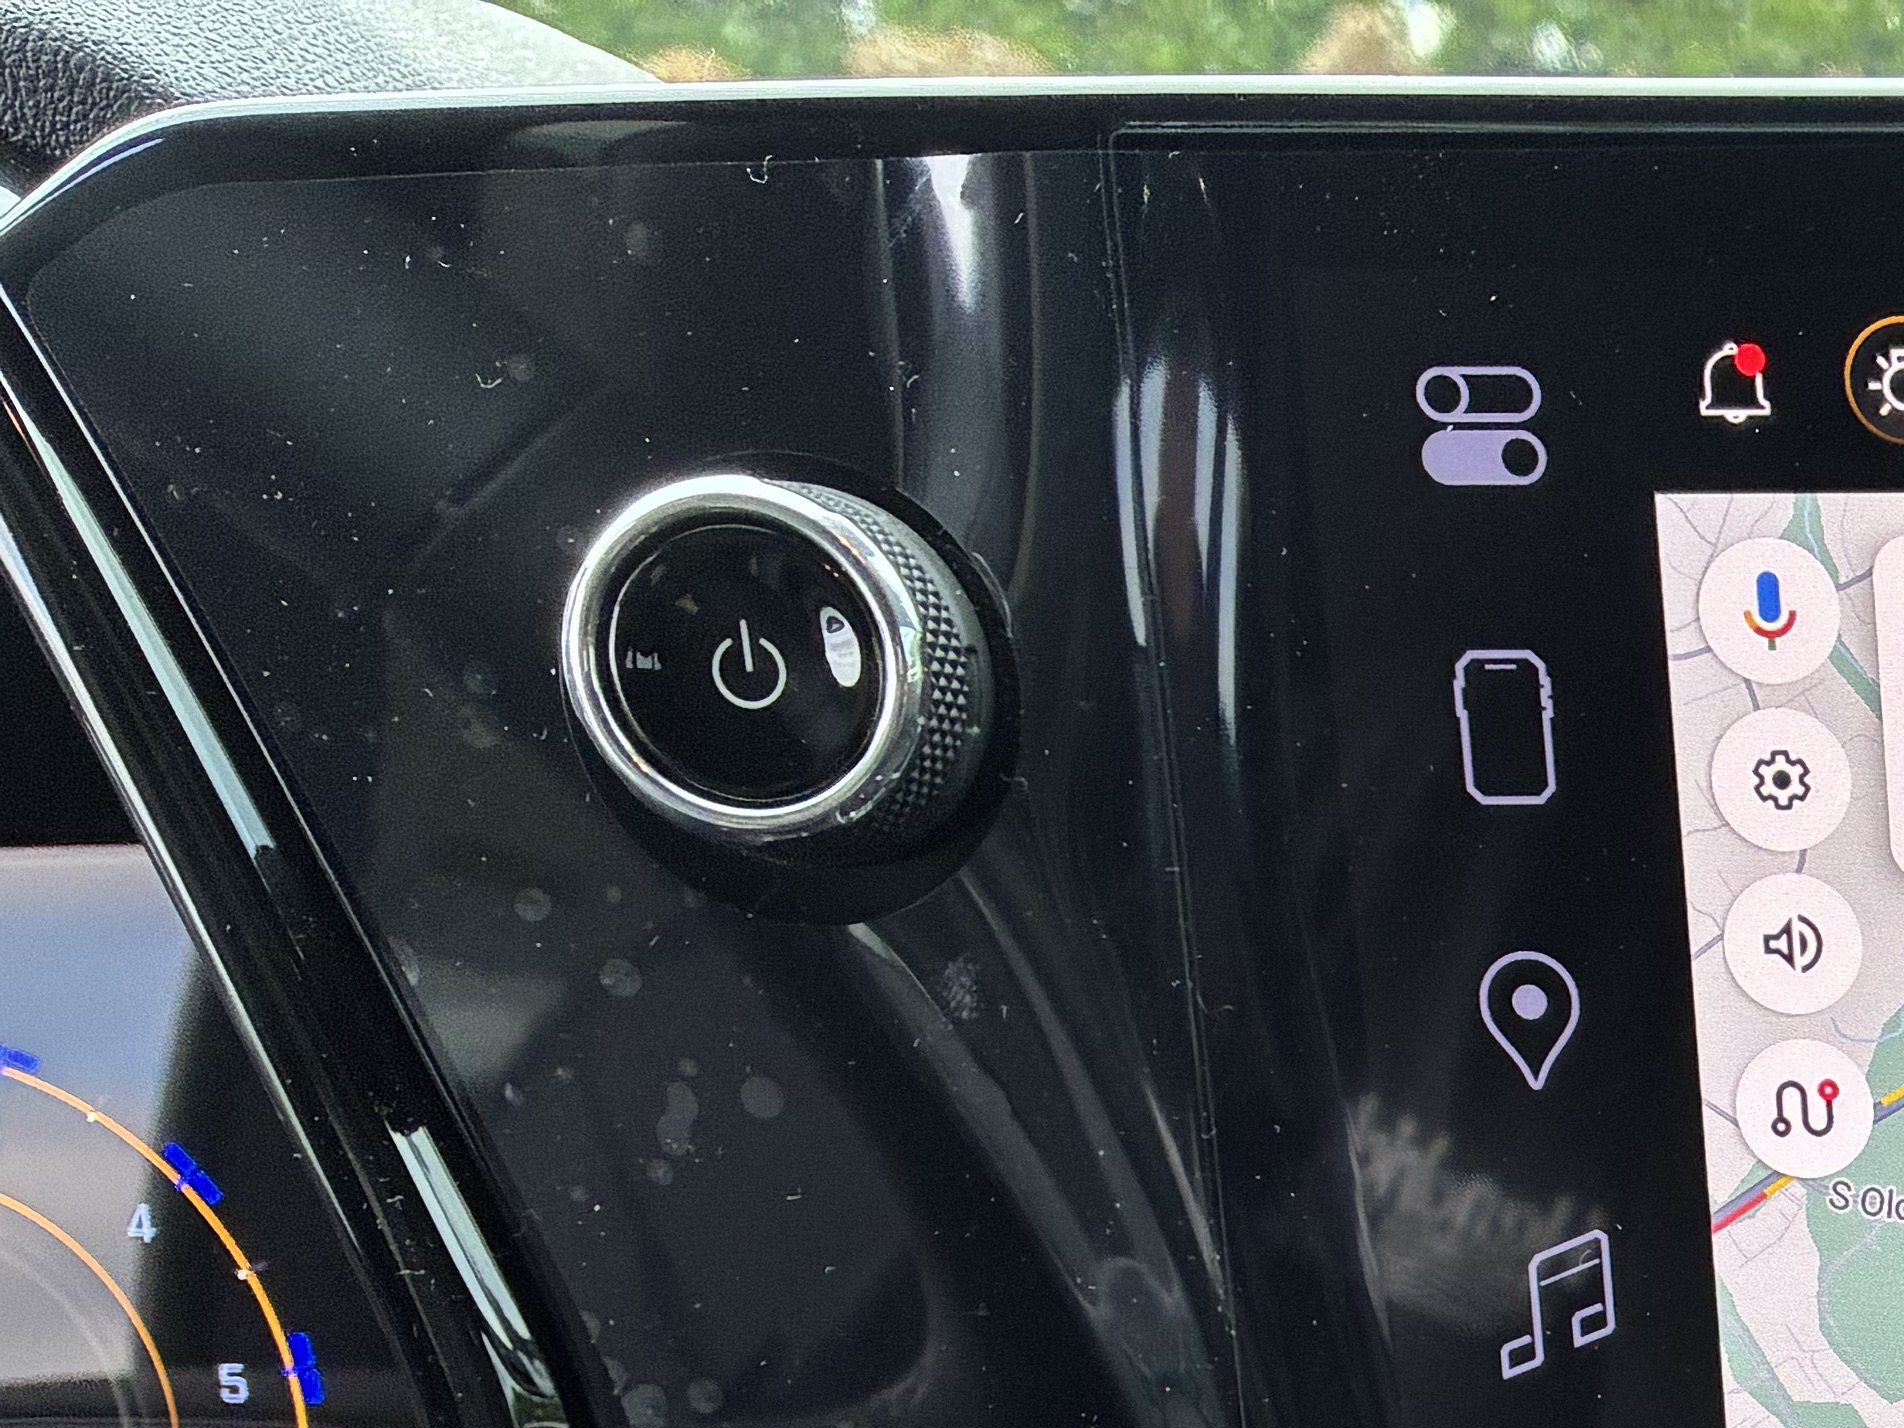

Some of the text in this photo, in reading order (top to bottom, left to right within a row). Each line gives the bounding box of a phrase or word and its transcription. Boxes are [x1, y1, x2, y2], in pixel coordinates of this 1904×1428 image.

[1829, 1182, 1853, 1212] S
[126, 1203, 156, 1243] 4
[218, 1363, 248, 1403] 5
